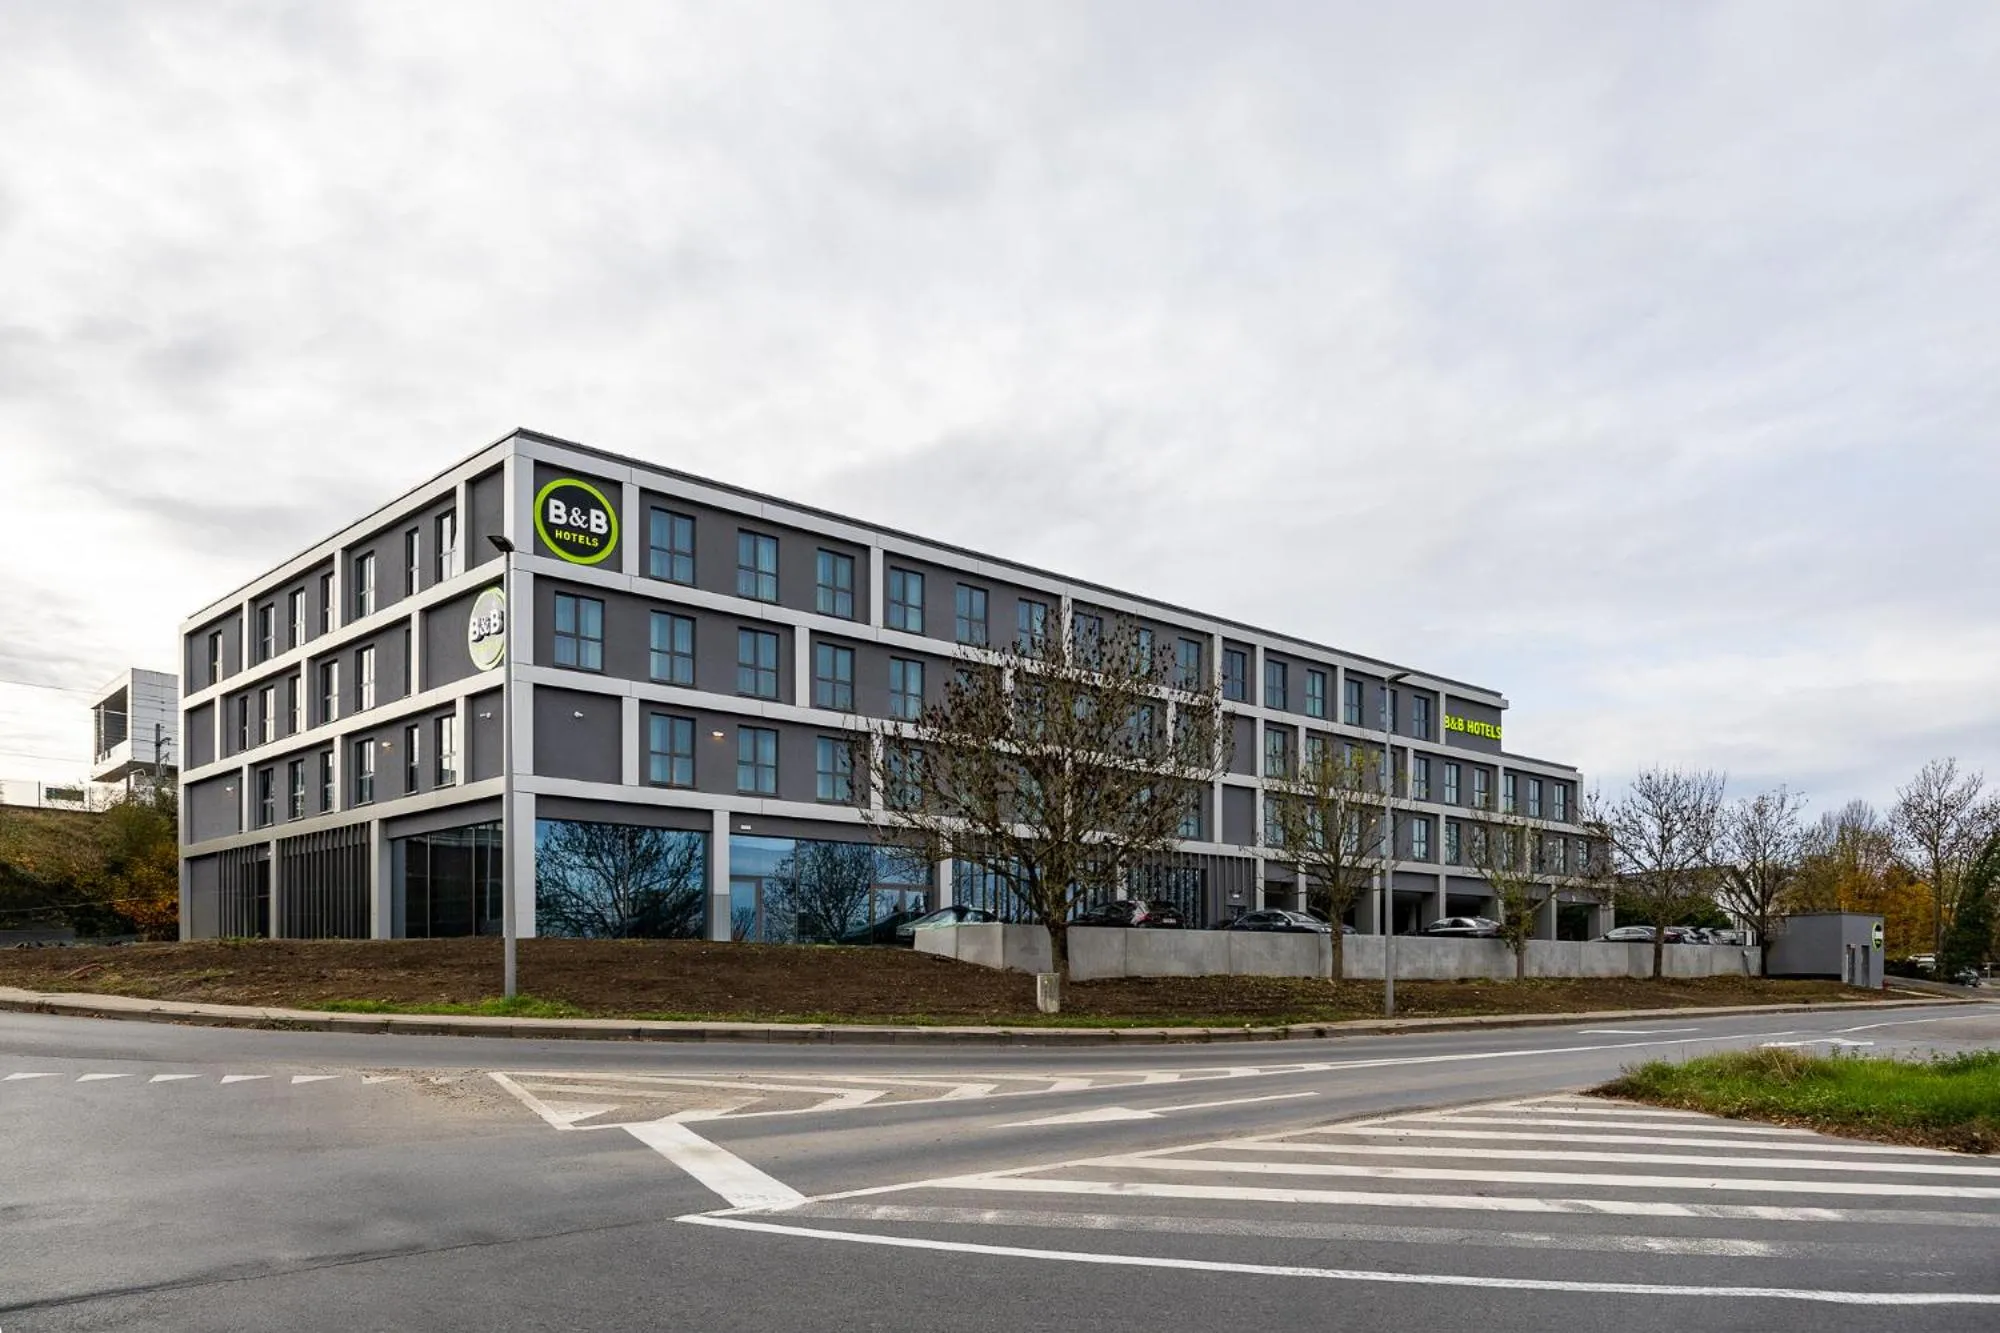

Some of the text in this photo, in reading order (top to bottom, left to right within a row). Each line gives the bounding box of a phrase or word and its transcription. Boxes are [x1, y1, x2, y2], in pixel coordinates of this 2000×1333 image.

[549, 498, 608, 534] B&B
[555, 529, 599, 547] HOTELS
[470, 608, 503, 641] B&B
[1444, 715, 1503, 739] B&B HOTELS
